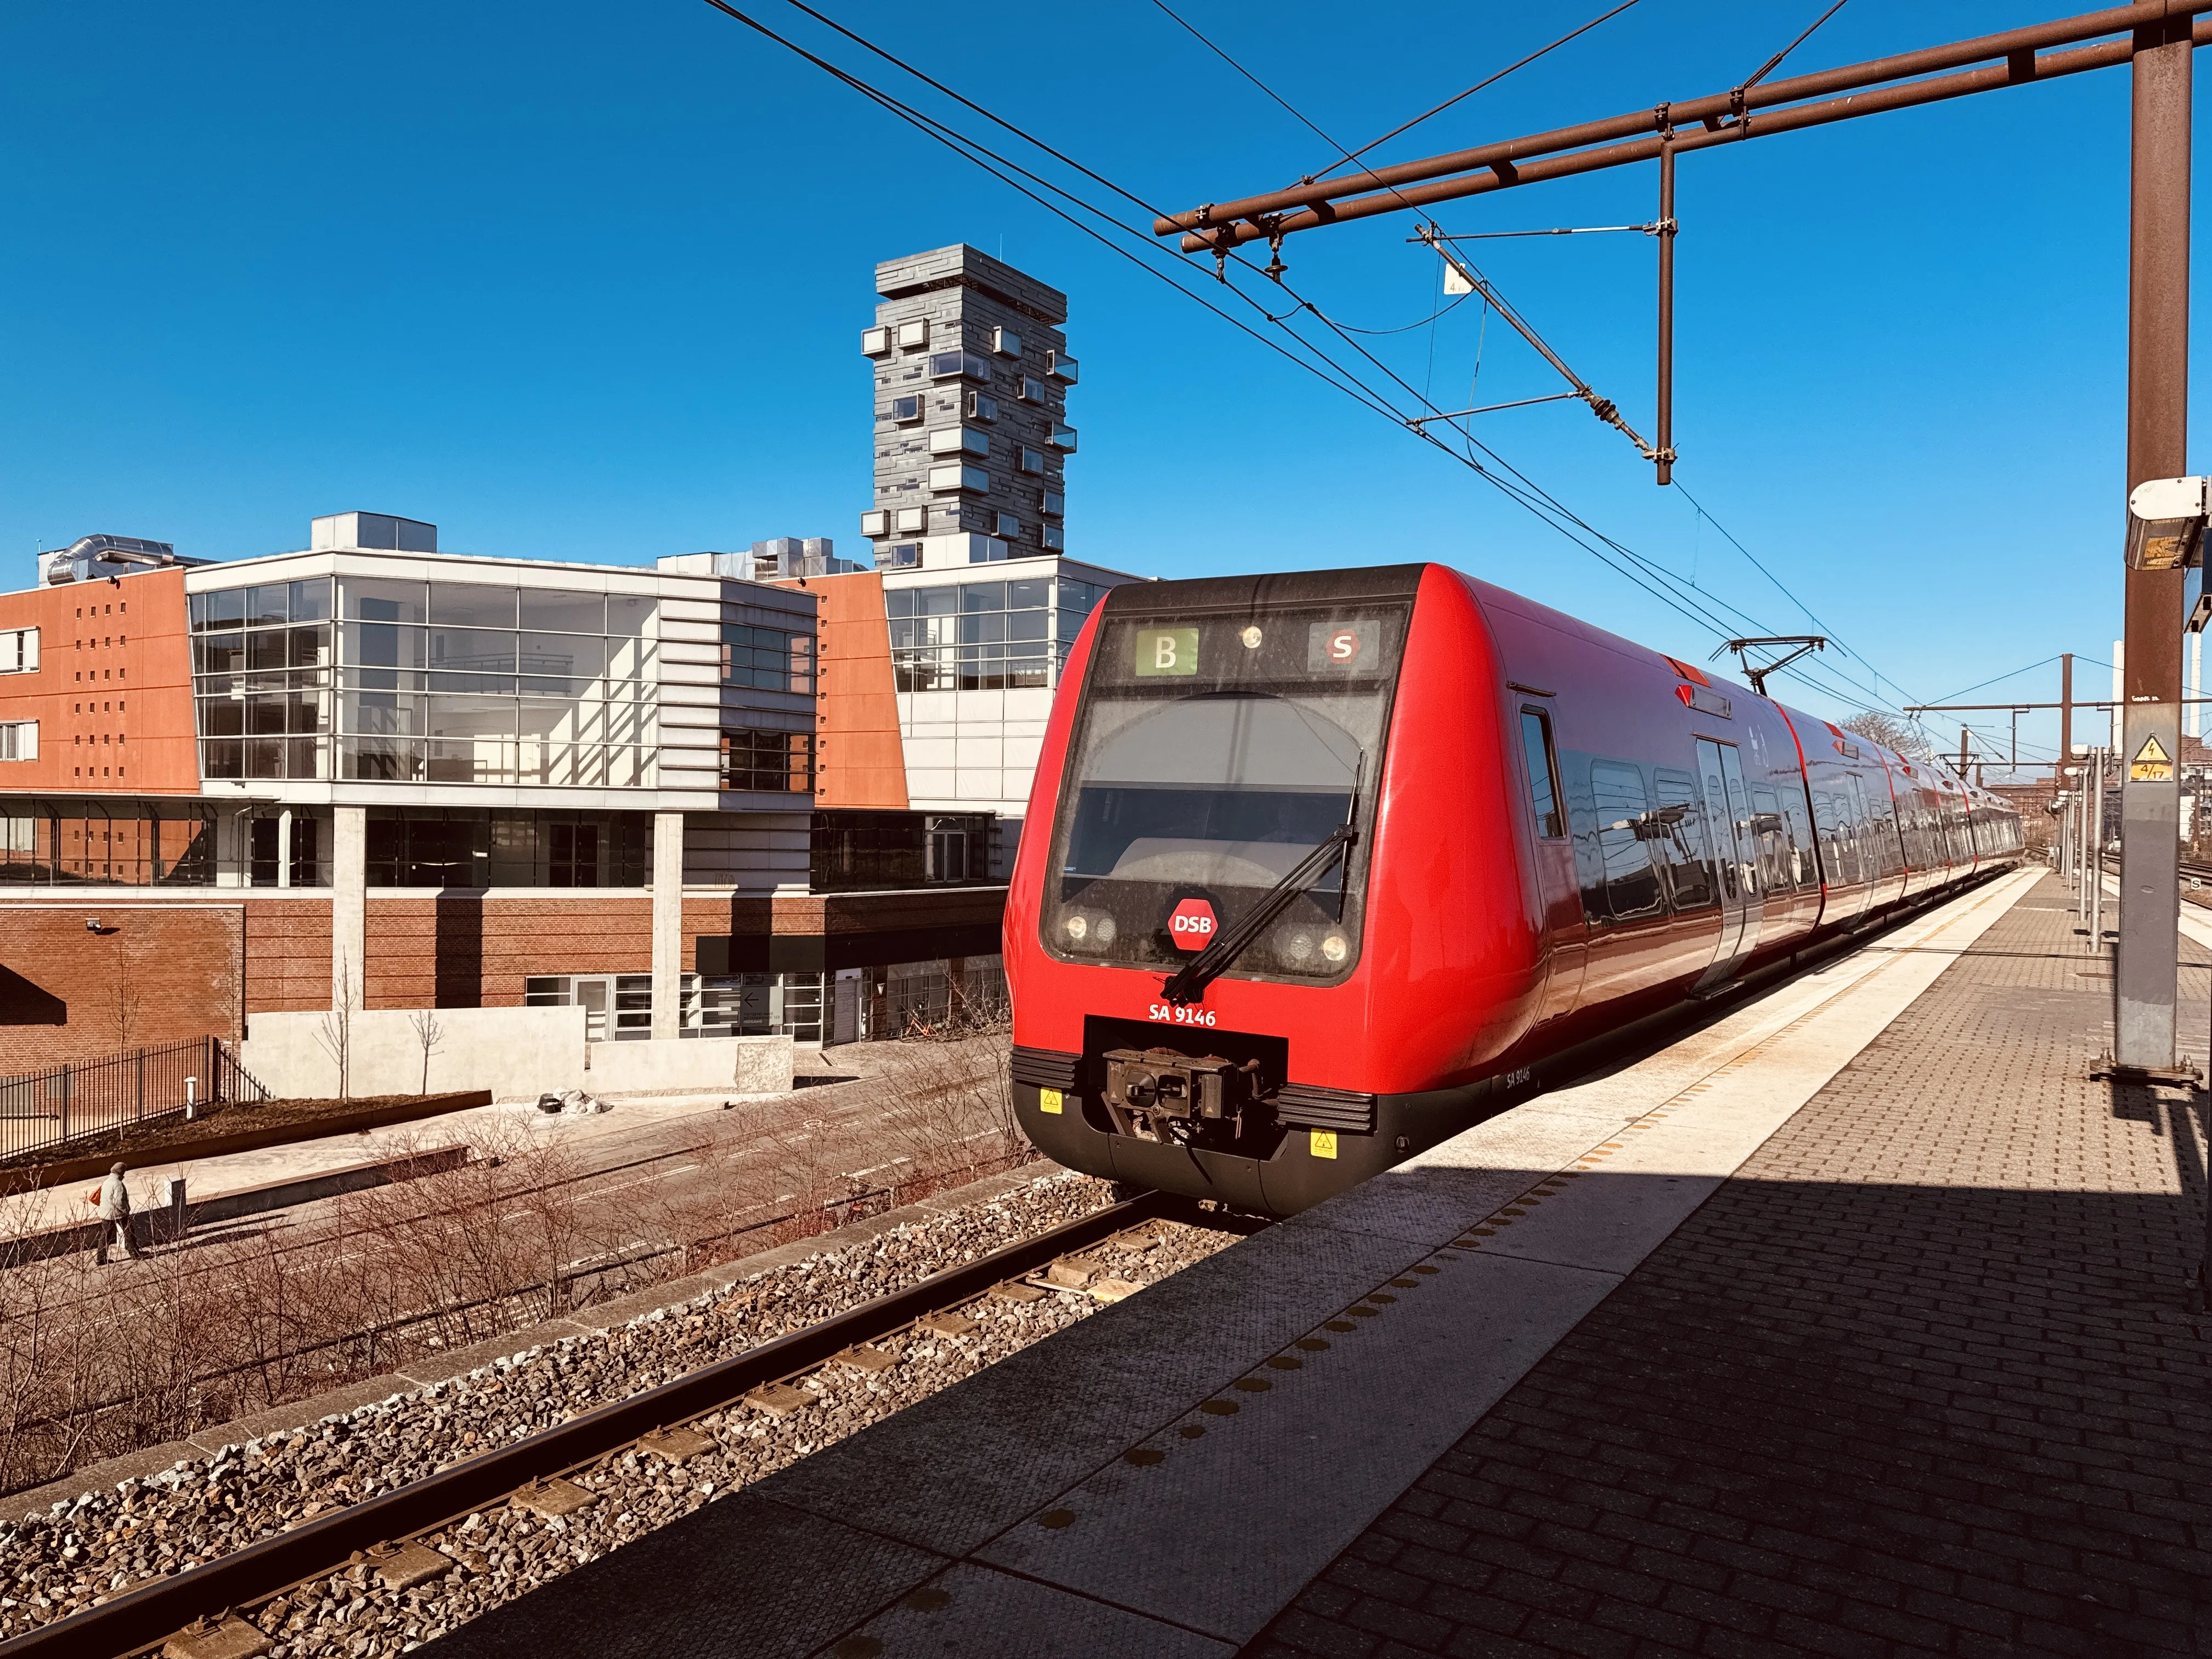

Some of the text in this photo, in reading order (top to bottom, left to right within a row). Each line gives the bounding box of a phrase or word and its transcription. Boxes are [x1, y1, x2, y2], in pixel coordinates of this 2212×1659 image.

[1155, 636, 1176, 668] B
[1333, 635, 1352, 658] S
[2192, 880, 2200, 888] S
[1175, 915, 1211, 933] DSB
[1148, 1004, 1216, 1026] SA 9146
[1507, 1066, 1530, 1089] SA 9146
